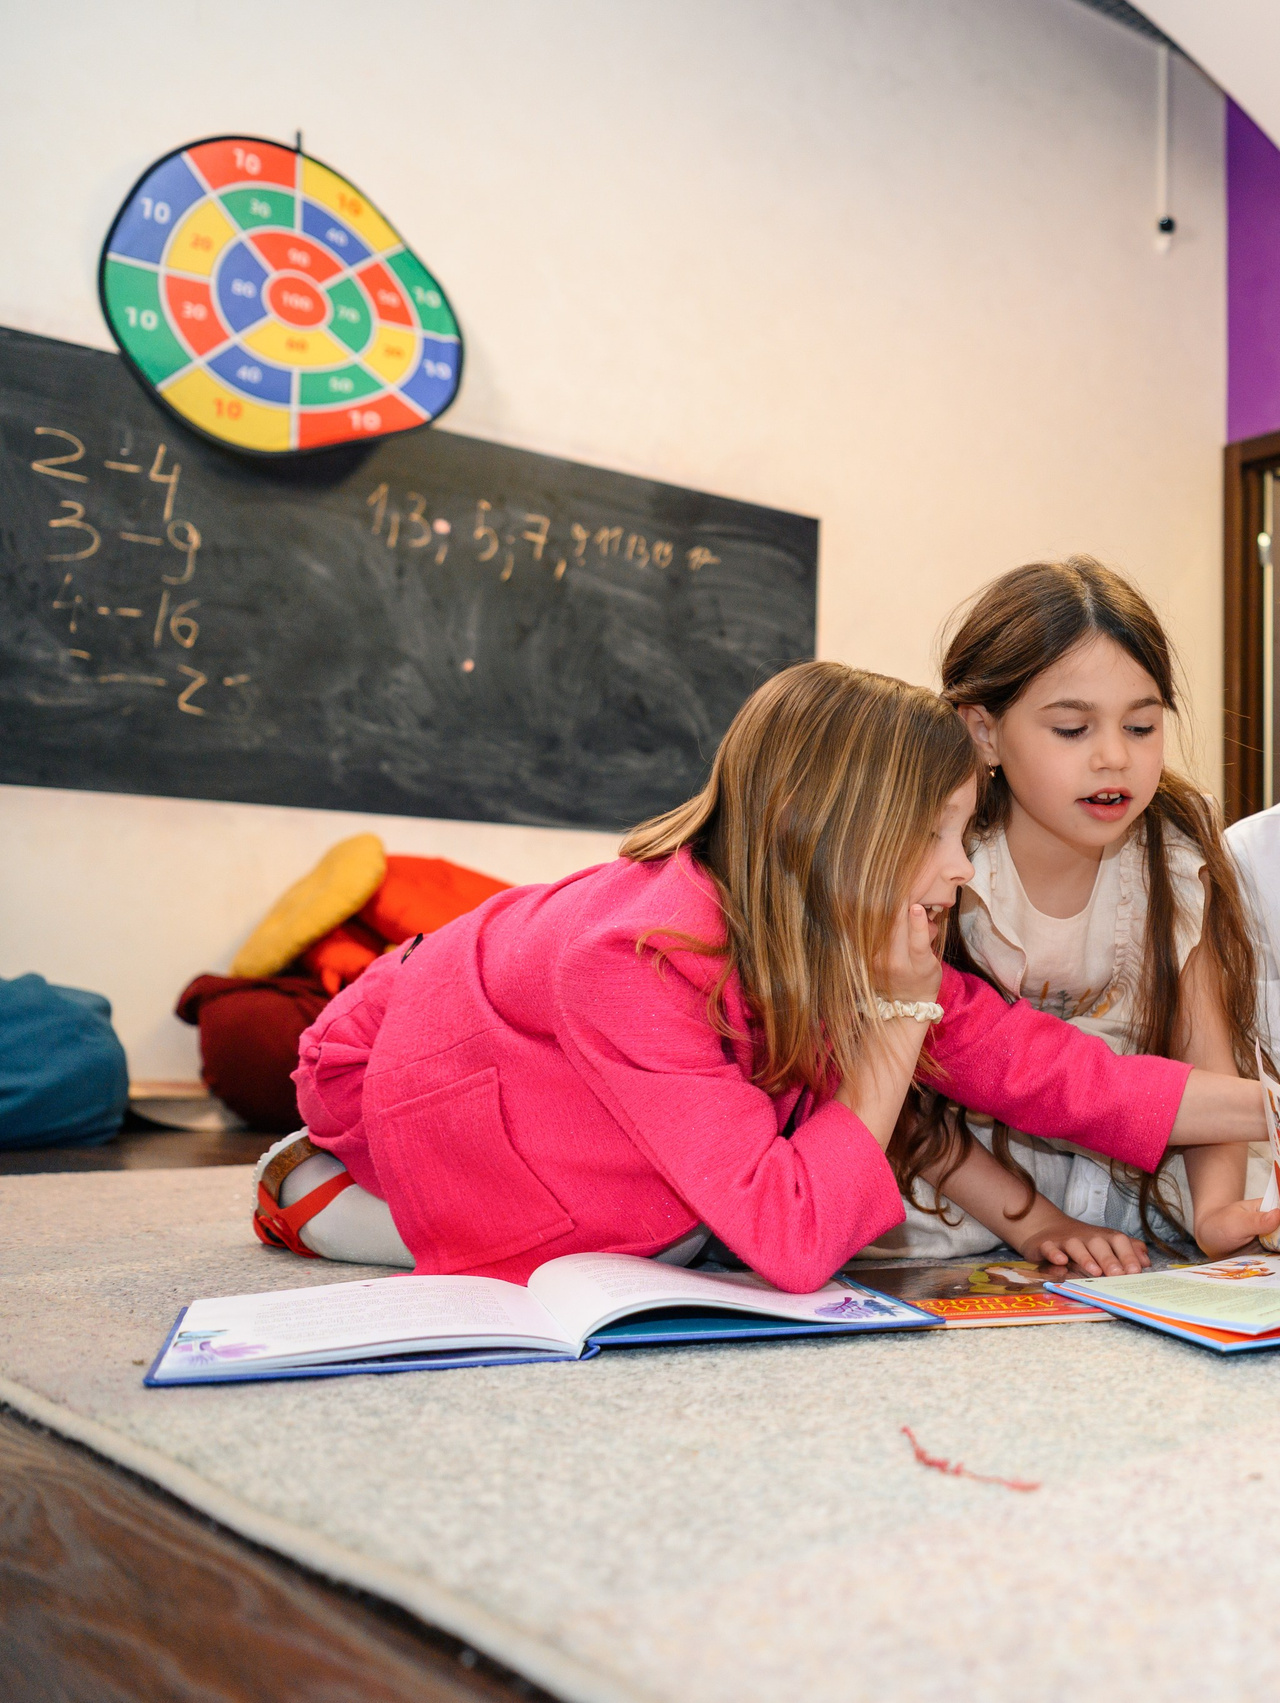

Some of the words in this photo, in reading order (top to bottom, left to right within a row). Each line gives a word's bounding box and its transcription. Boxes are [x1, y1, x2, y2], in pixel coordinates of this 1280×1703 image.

[232, 147, 262, 176] 10
[140, 197, 171, 225] 10
[337, 190, 364, 218] 10
[411, 285, 442, 309] 10
[125, 306, 158, 331] 10
[181, 301, 208, 322] 30
[422, 358, 452, 381] 10
[213, 397, 243, 421] 10
[348, 409, 382, 431] 10
[154, 590, 200, 648] 16
[921, 1300, 1055, 1313] ЛОШАД
